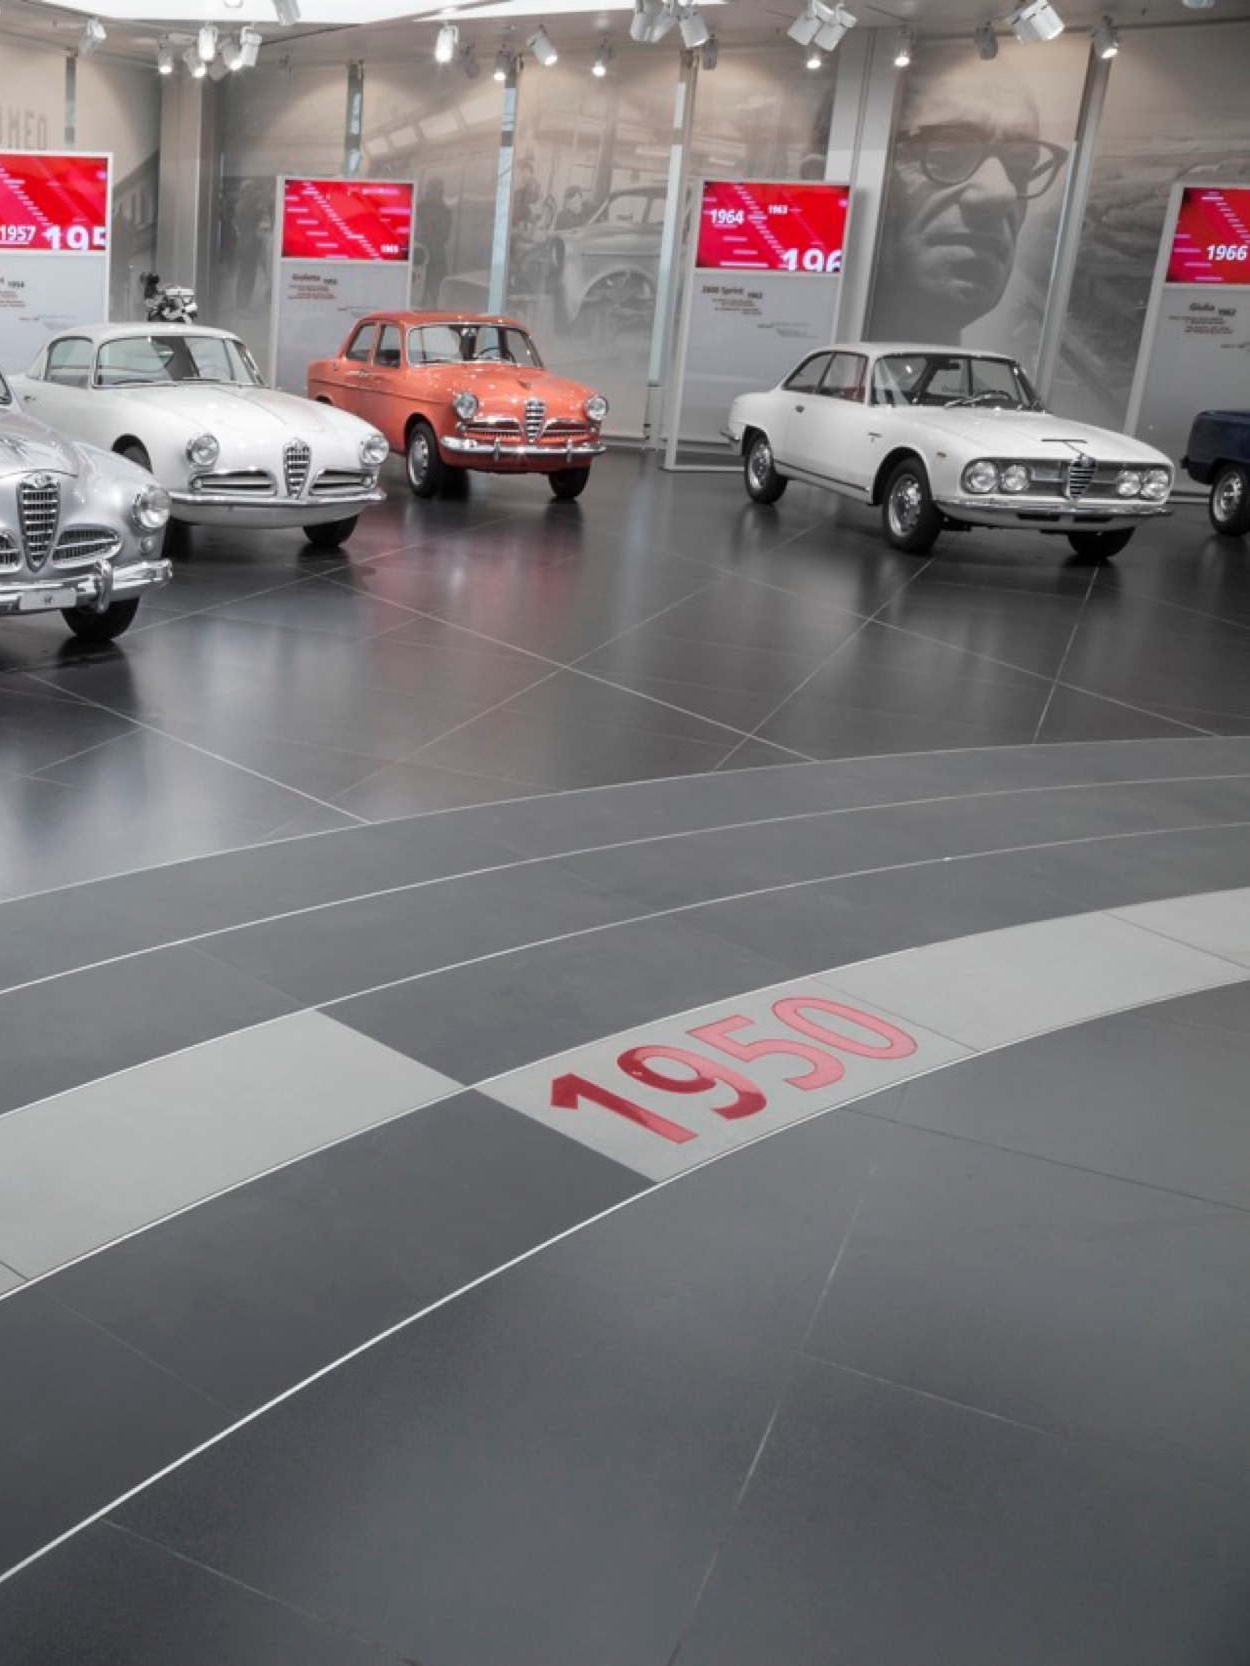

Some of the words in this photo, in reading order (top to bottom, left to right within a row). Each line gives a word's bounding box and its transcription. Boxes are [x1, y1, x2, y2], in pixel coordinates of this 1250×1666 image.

[710, 208, 745, 225] 1964
[0, 224, 36, 242] 1957
[1206, 243, 1249, 261] 1966
[550, 995, 918, 1145] 1950
